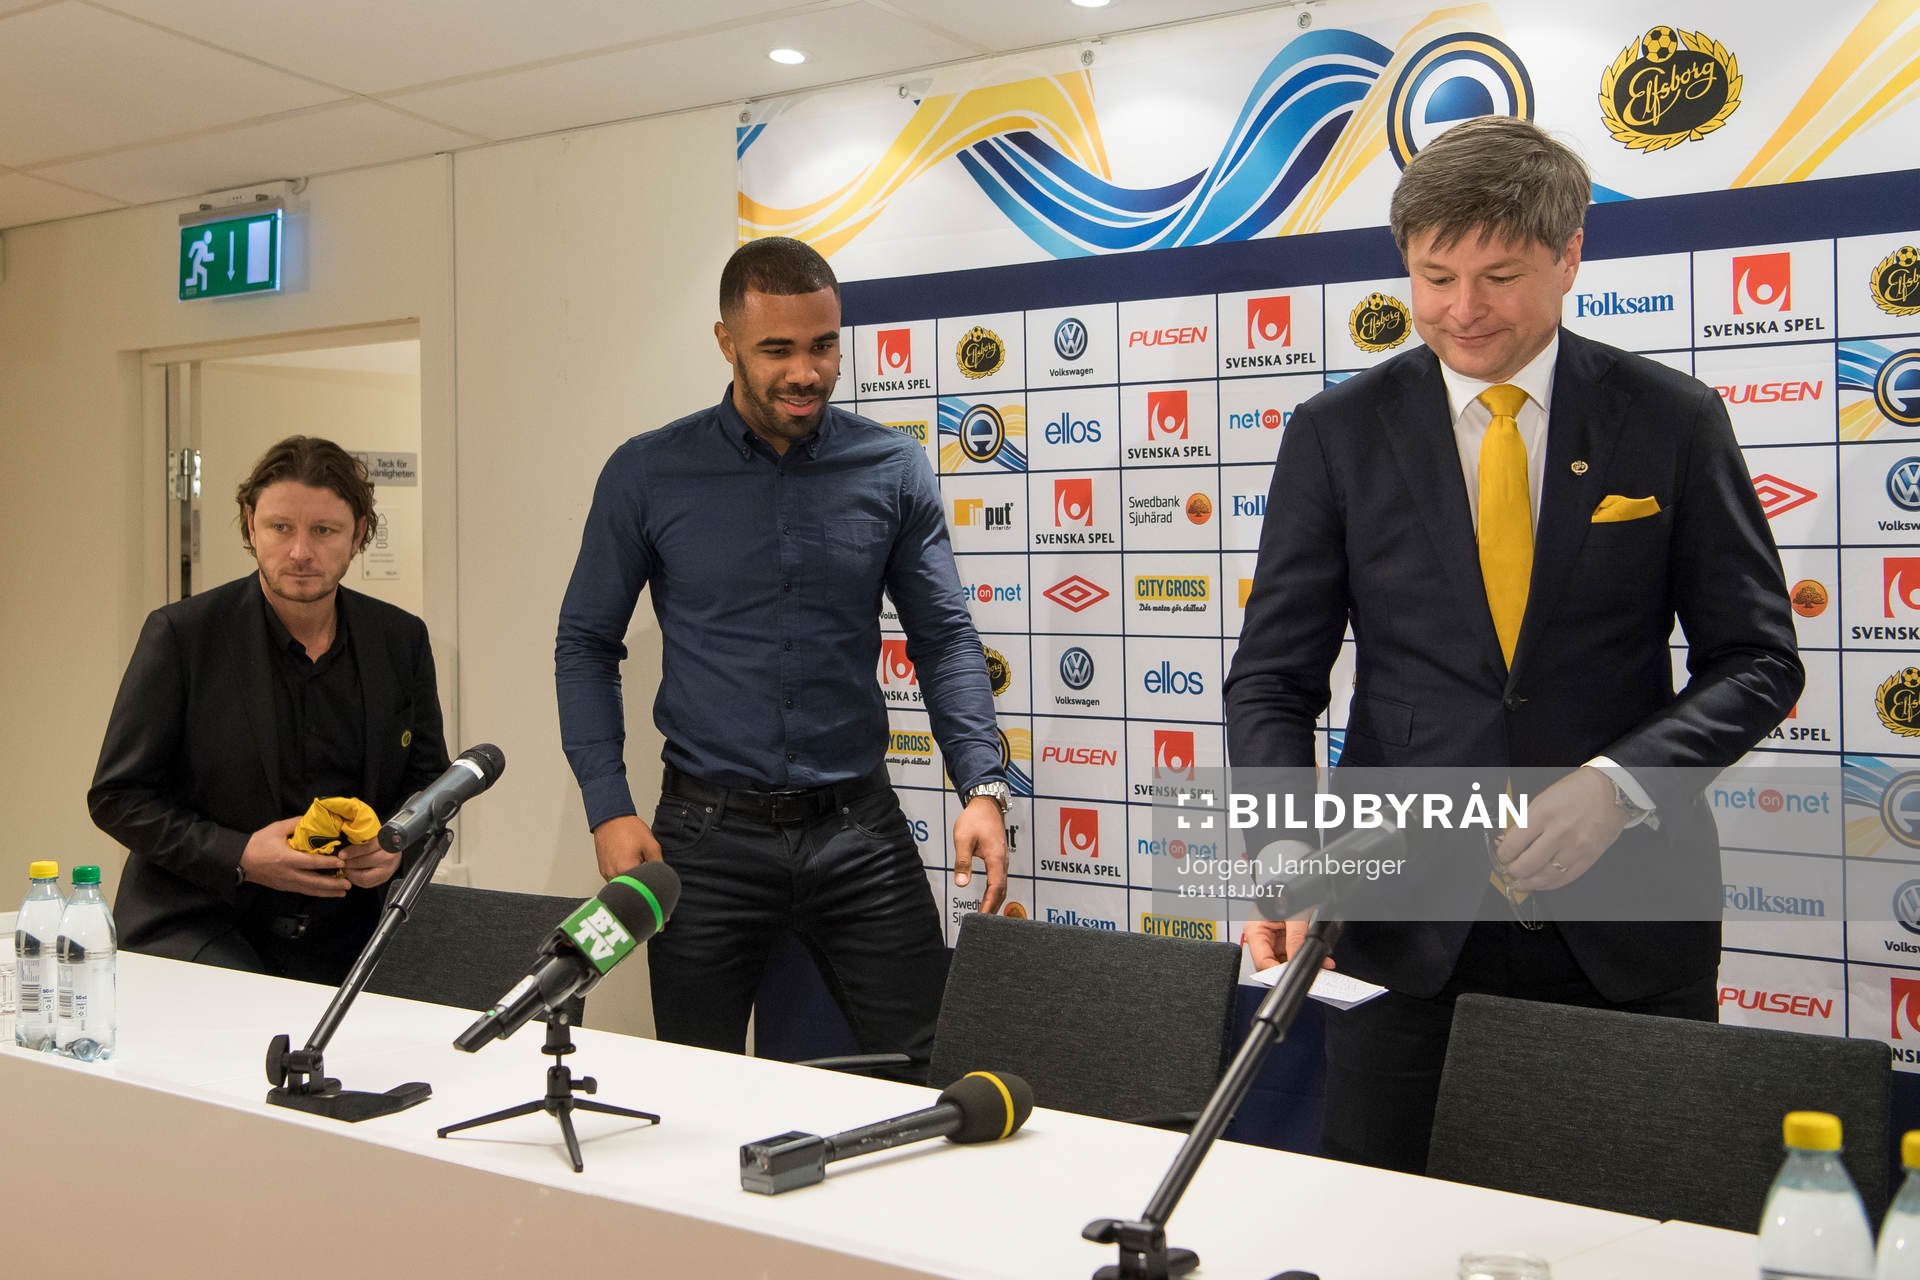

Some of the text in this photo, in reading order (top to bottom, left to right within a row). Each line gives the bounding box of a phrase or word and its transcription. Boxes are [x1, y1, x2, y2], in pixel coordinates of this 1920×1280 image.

[1623, 61, 1717, 126] Elfsborg
[1884, 268, 1920, 302] Elfsb
[1576, 292, 1675, 318] Folksam
[1129, 326, 1208, 348] PULSEN
[1703, 317, 1825, 338] SVENSKA SPEL
[1225, 352, 1317, 369] SVENSKA SPEL
[1049, 367, 1094, 376] Volkswagen
[861, 378, 932, 393] SVENSKA SPEL
[1714, 380, 1823, 404] PULSEN
[1045, 412, 1101, 445] ellos
[1127, 444, 1212, 460] SVENSKA SPEL
[1128, 496, 1180, 510] Swedbank
[1129, 510, 1173, 526] Sjuhärad
[1878, 520, 1920, 531] Volksw
[1035, 532, 1115, 545] SVENSKA SPEL
[1137, 578, 1206, 598] CITY GROSS
[1851, 626, 1920, 640] SVENSK
[1144, 660, 1204, 695] ellos
[883, 690, 910, 702] NSKA
[1055, 695, 1100, 707] Volkswagen
[896, 734, 931, 752] GROSS
[1790, 727, 1831, 741] SPEL
[1042, 745, 1118, 767] PULSEN
[1134, 784, 1186, 799] SVENSKA
[1040, 859, 1121, 878] SVENSKA SPEL
[952, 897, 981, 911] Swed
[1722, 884, 1826, 917] Folksam
[587, 906, 630, 949] BT
[1046, 908, 1116, 931] Folksam
[1143, 916, 1213, 941] CITY GROSS
[573, 917, 616, 961] TV
[1884, 940, 1920, 954] Volks
[1718, 987, 1833, 1019] PULSEN
